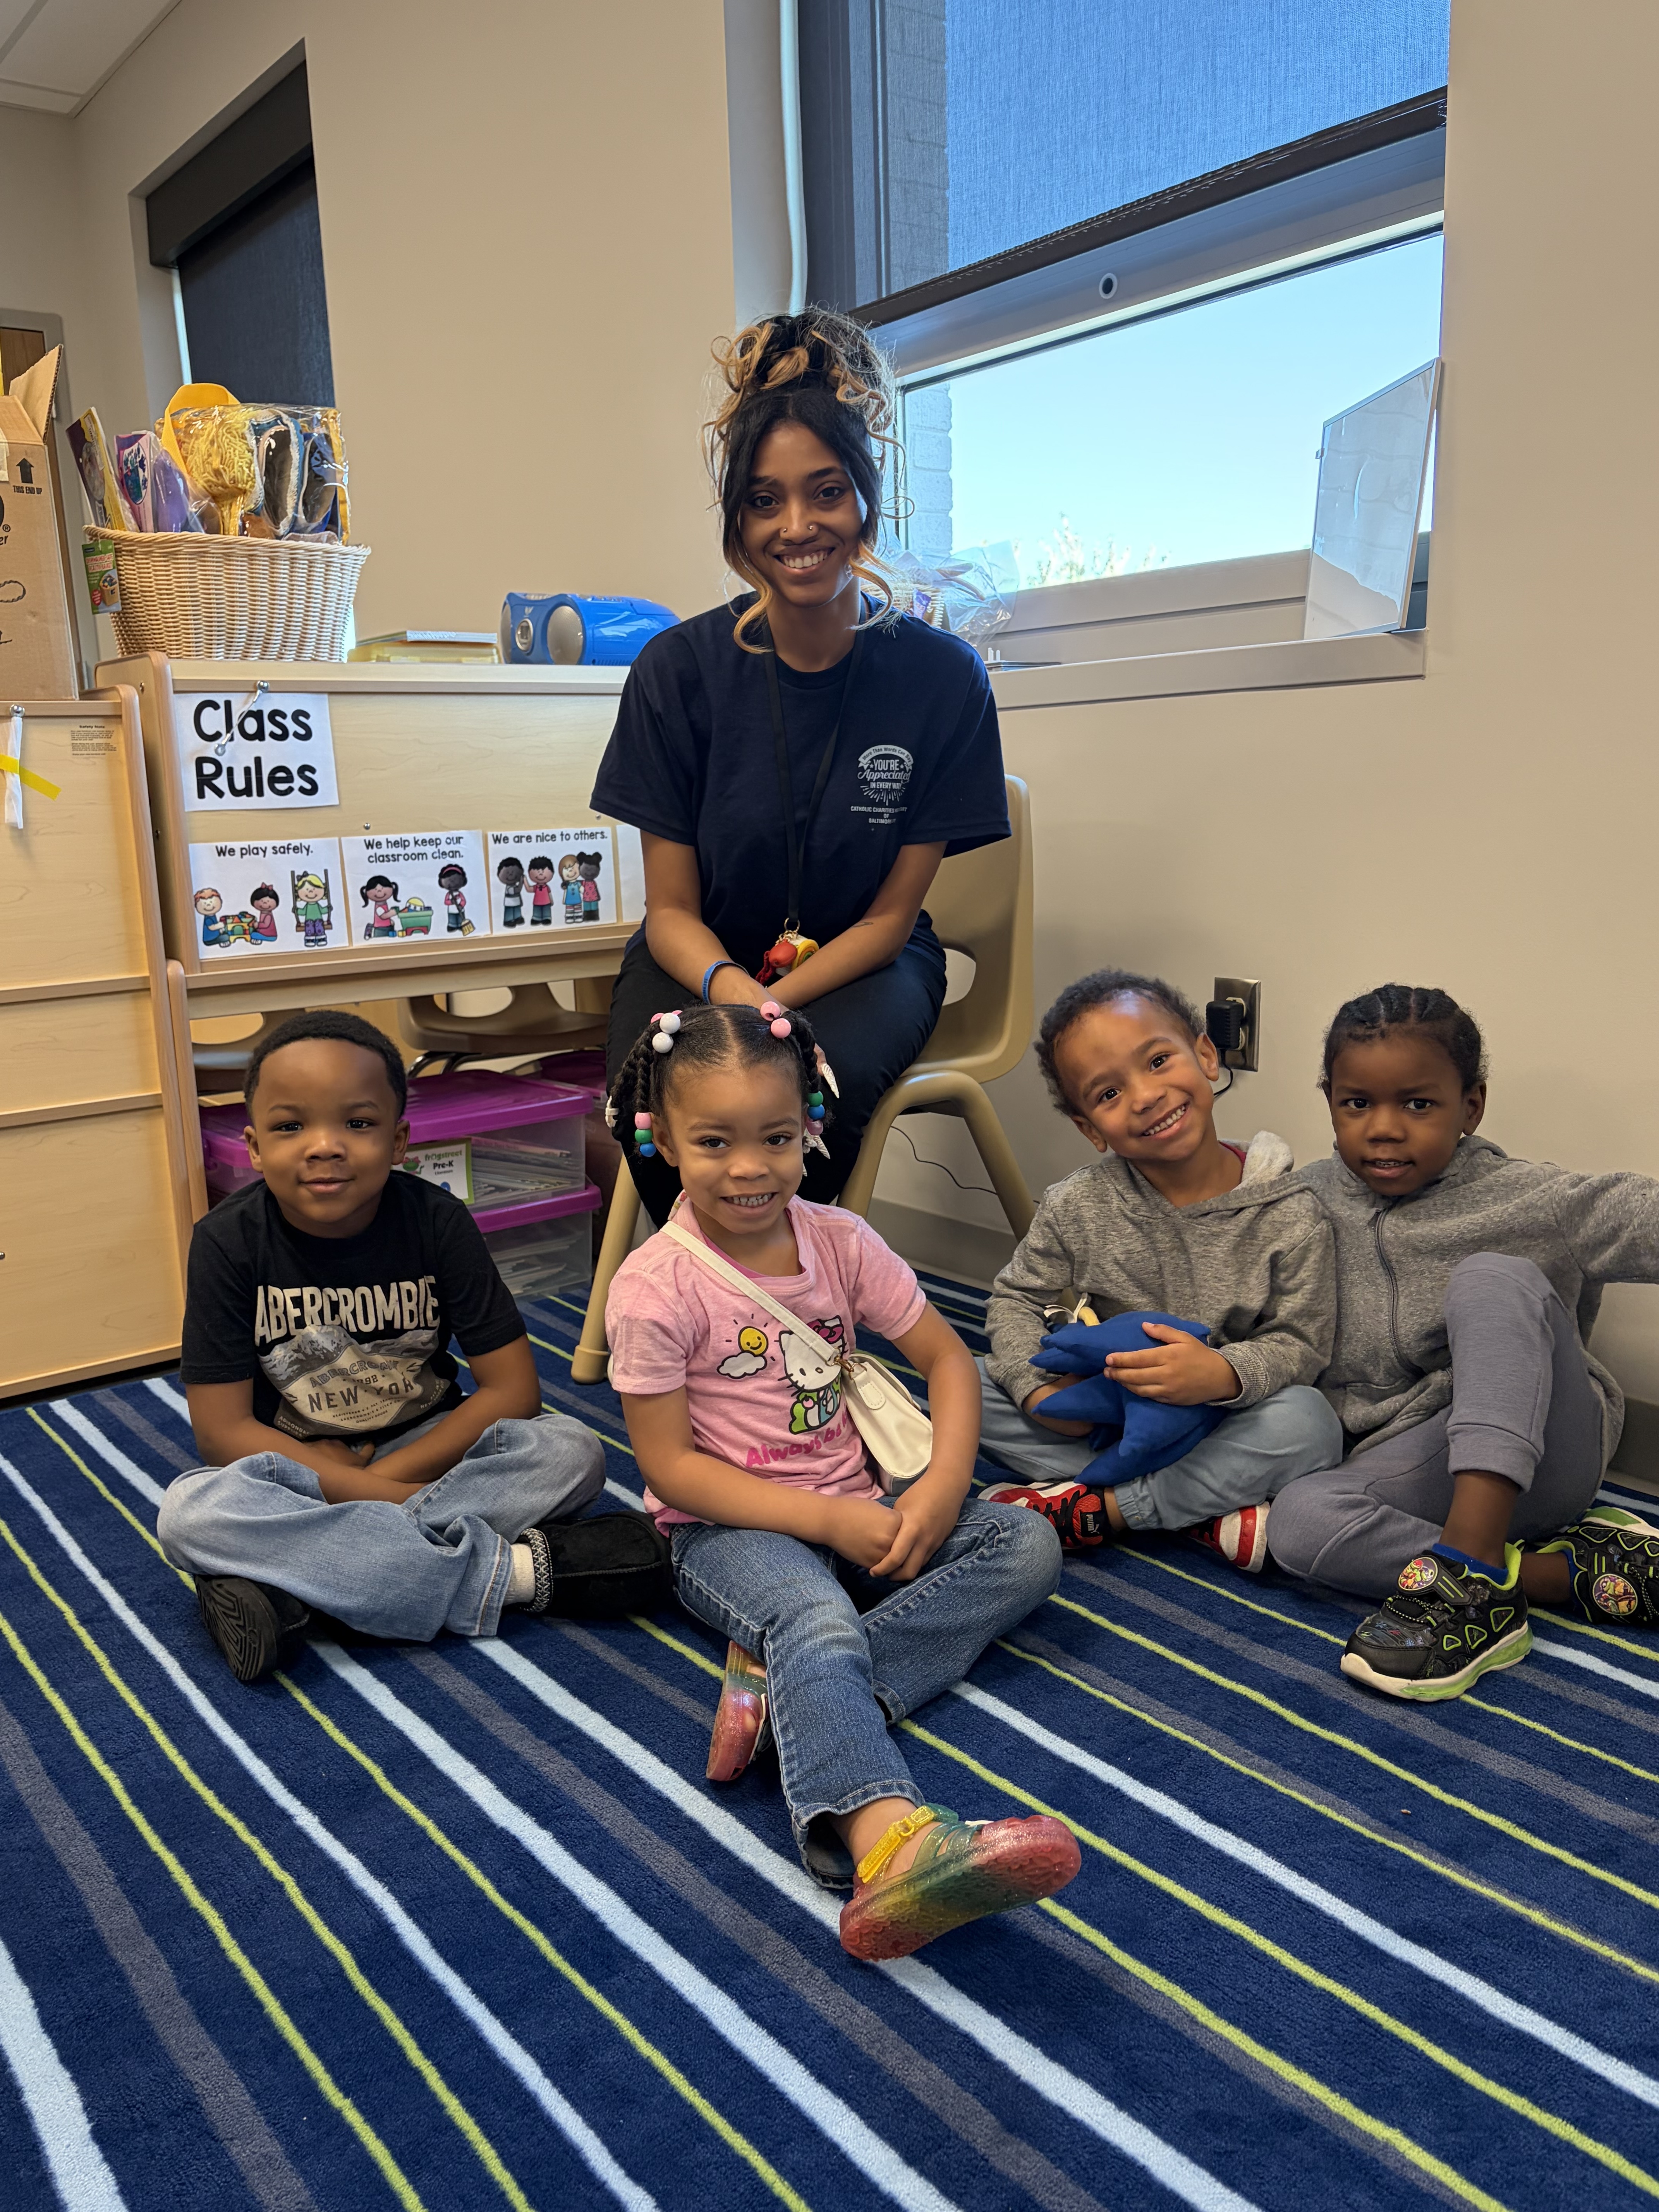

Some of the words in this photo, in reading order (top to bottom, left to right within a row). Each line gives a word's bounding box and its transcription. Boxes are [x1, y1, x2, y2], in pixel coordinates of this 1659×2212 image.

[12, 485, 24, 493] THIS
[194, 699, 313, 742] Class
[862, 752, 872, 761] More
[873, 759, 900, 771] YOU'RE
[195, 756, 319, 799] Rules
[857, 769, 912, 784] Appreciated
[364, 838, 383, 850] We
[386, 837, 410, 850] help
[414, 836, 441, 848] keep
[445, 836, 464, 845] our
[492, 833, 509, 844] We
[513, 834, 532, 843] are
[536, 832, 556, 843] nice
[561, 831, 570, 842] to
[574, 830, 608, 841] others.
[215, 845, 235, 857] We
[240, 844, 267, 859] play
[272, 842, 313, 856] safely.
[368, 852, 428, 864] classroom
[431, 849, 464, 859] clean.
[433, 1160, 453, 1170] Pre-K
[255, 1275, 440, 1346] ABERCROMBIE
[308, 1386, 358, 1413] NEW
[746, 1435, 822, 1467] Always
[1086, 1514, 1094, 1531] PUMA
